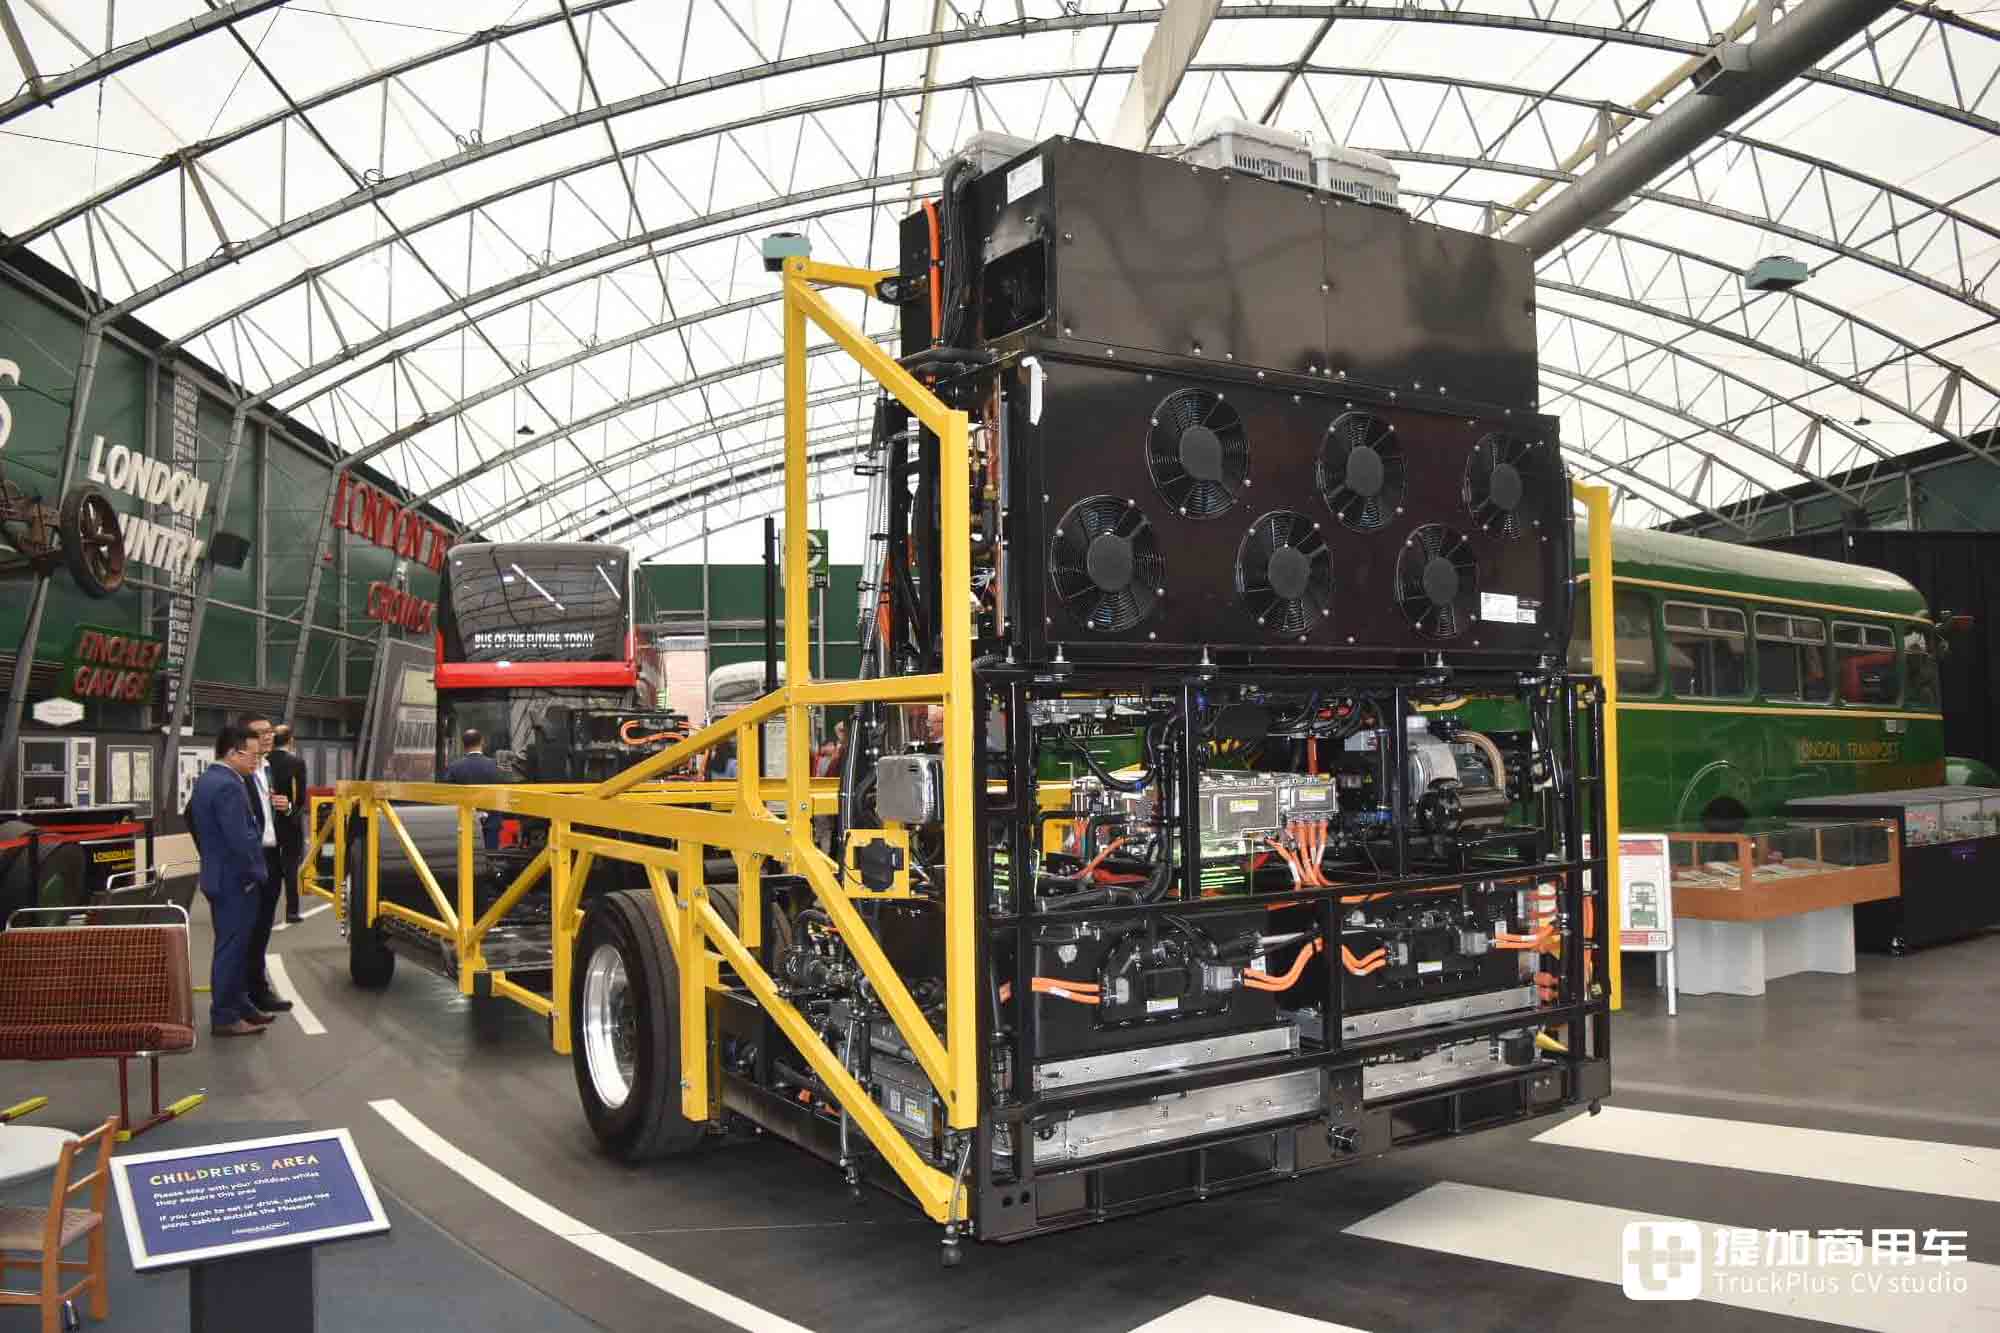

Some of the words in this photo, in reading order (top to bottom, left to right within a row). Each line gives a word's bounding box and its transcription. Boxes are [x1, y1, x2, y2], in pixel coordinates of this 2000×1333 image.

[88, 434, 208, 520] LONDON
[334, 470, 421, 562] LONDON
[118, 511, 205, 580] UNTRY
[474, 632, 492, 648] BUS
[494, 632, 506, 648] OF
[507, 632, 526, 648] THE
[563, 632, 595, 648] TODAY
[73, 665, 148, 700] GARAGE
[1799, 736, 1840, 761] LONDON
[149, 1161, 263, 1186] CHILDREN'S
[271, 1153, 320, 1171] AREA
[153, 1190, 184, 1199] Please
[208, 1184, 229, 1193] with
[230, 1181, 251, 1190] your
[254, 1175, 292, 1185] children
[180, 1193, 215, 1205] explore
[217, 1191, 235, 1200] this
[169, 1212, 188, 1222] you
[191, 1209, 213, 1219] wish
[191, 1216, 221, 1226] tables
[223, 1211, 259, 1221] outside
[261, 1207, 276, 1215] the
